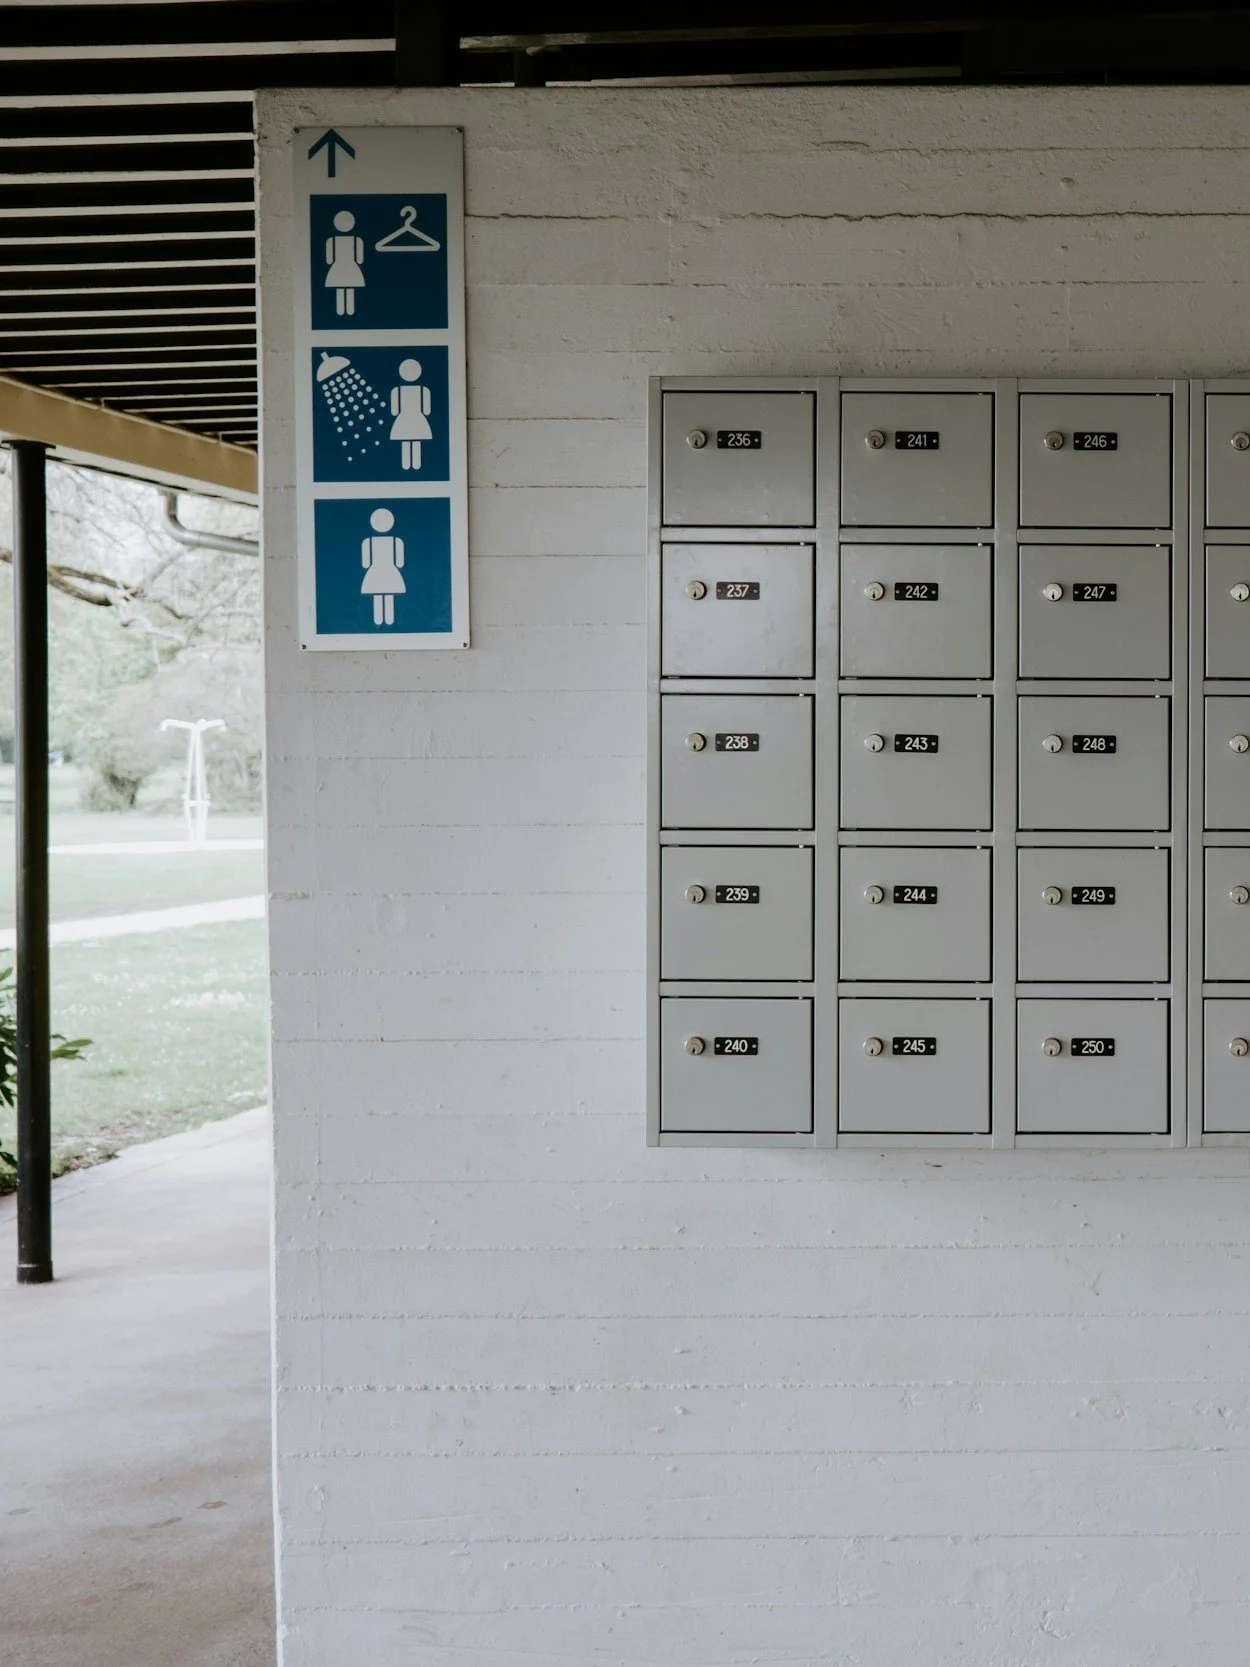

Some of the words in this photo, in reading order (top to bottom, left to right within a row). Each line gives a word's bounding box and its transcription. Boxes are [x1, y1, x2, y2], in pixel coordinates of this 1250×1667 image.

[727, 433, 751, 447] 236
[907, 433, 927, 447] 241
[1084, 434, 1108, 448] 246
[726, 584, 750, 598] 237
[905, 584, 928, 599] 242
[1083, 585, 1107, 600] 247
[725, 735, 749, 750] 238
[904, 736, 929, 751] 243
[1082, 737, 1106, 751] 248
[725, 887, 750, 902] 239
[903, 887, 927, 902] 244
[1081, 888, 1106, 903] 249
[724, 1039, 748, 1053] 240
[902, 1039, 926, 1053] 245
[1081, 1040, 1105, 1054] 250
